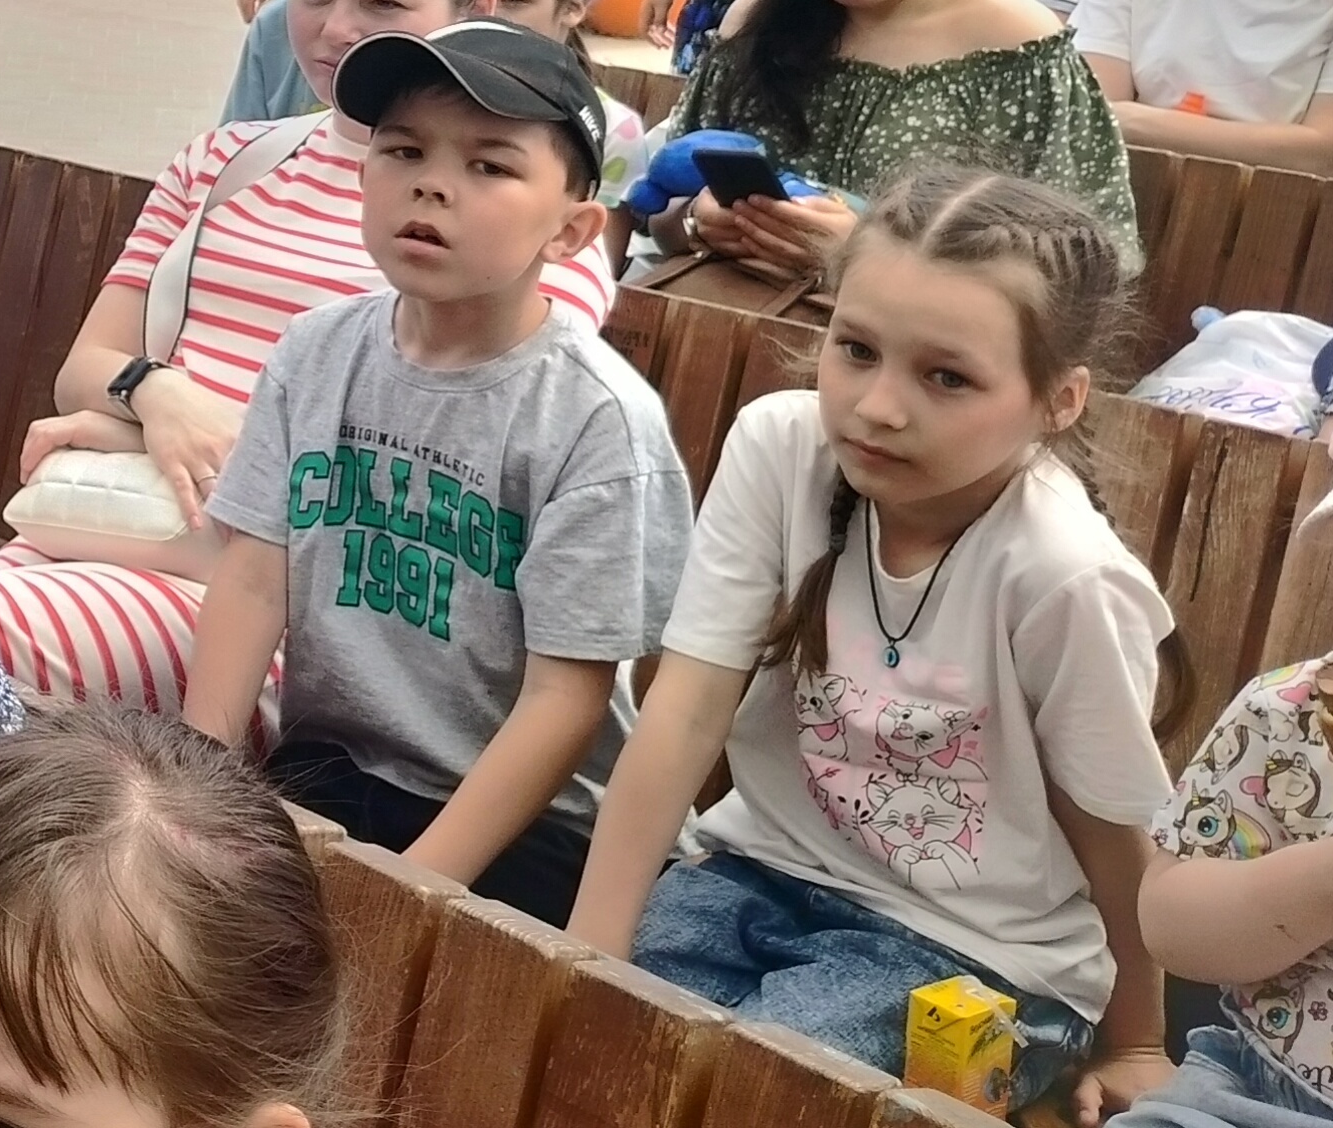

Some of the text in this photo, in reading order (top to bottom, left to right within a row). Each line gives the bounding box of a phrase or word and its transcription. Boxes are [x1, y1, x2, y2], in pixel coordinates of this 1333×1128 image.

[339, 424, 485, 487] ORIGINAL ATHLETIC
[288, 444, 524, 591] COLLEGE
[335, 529, 455, 642] 1991
